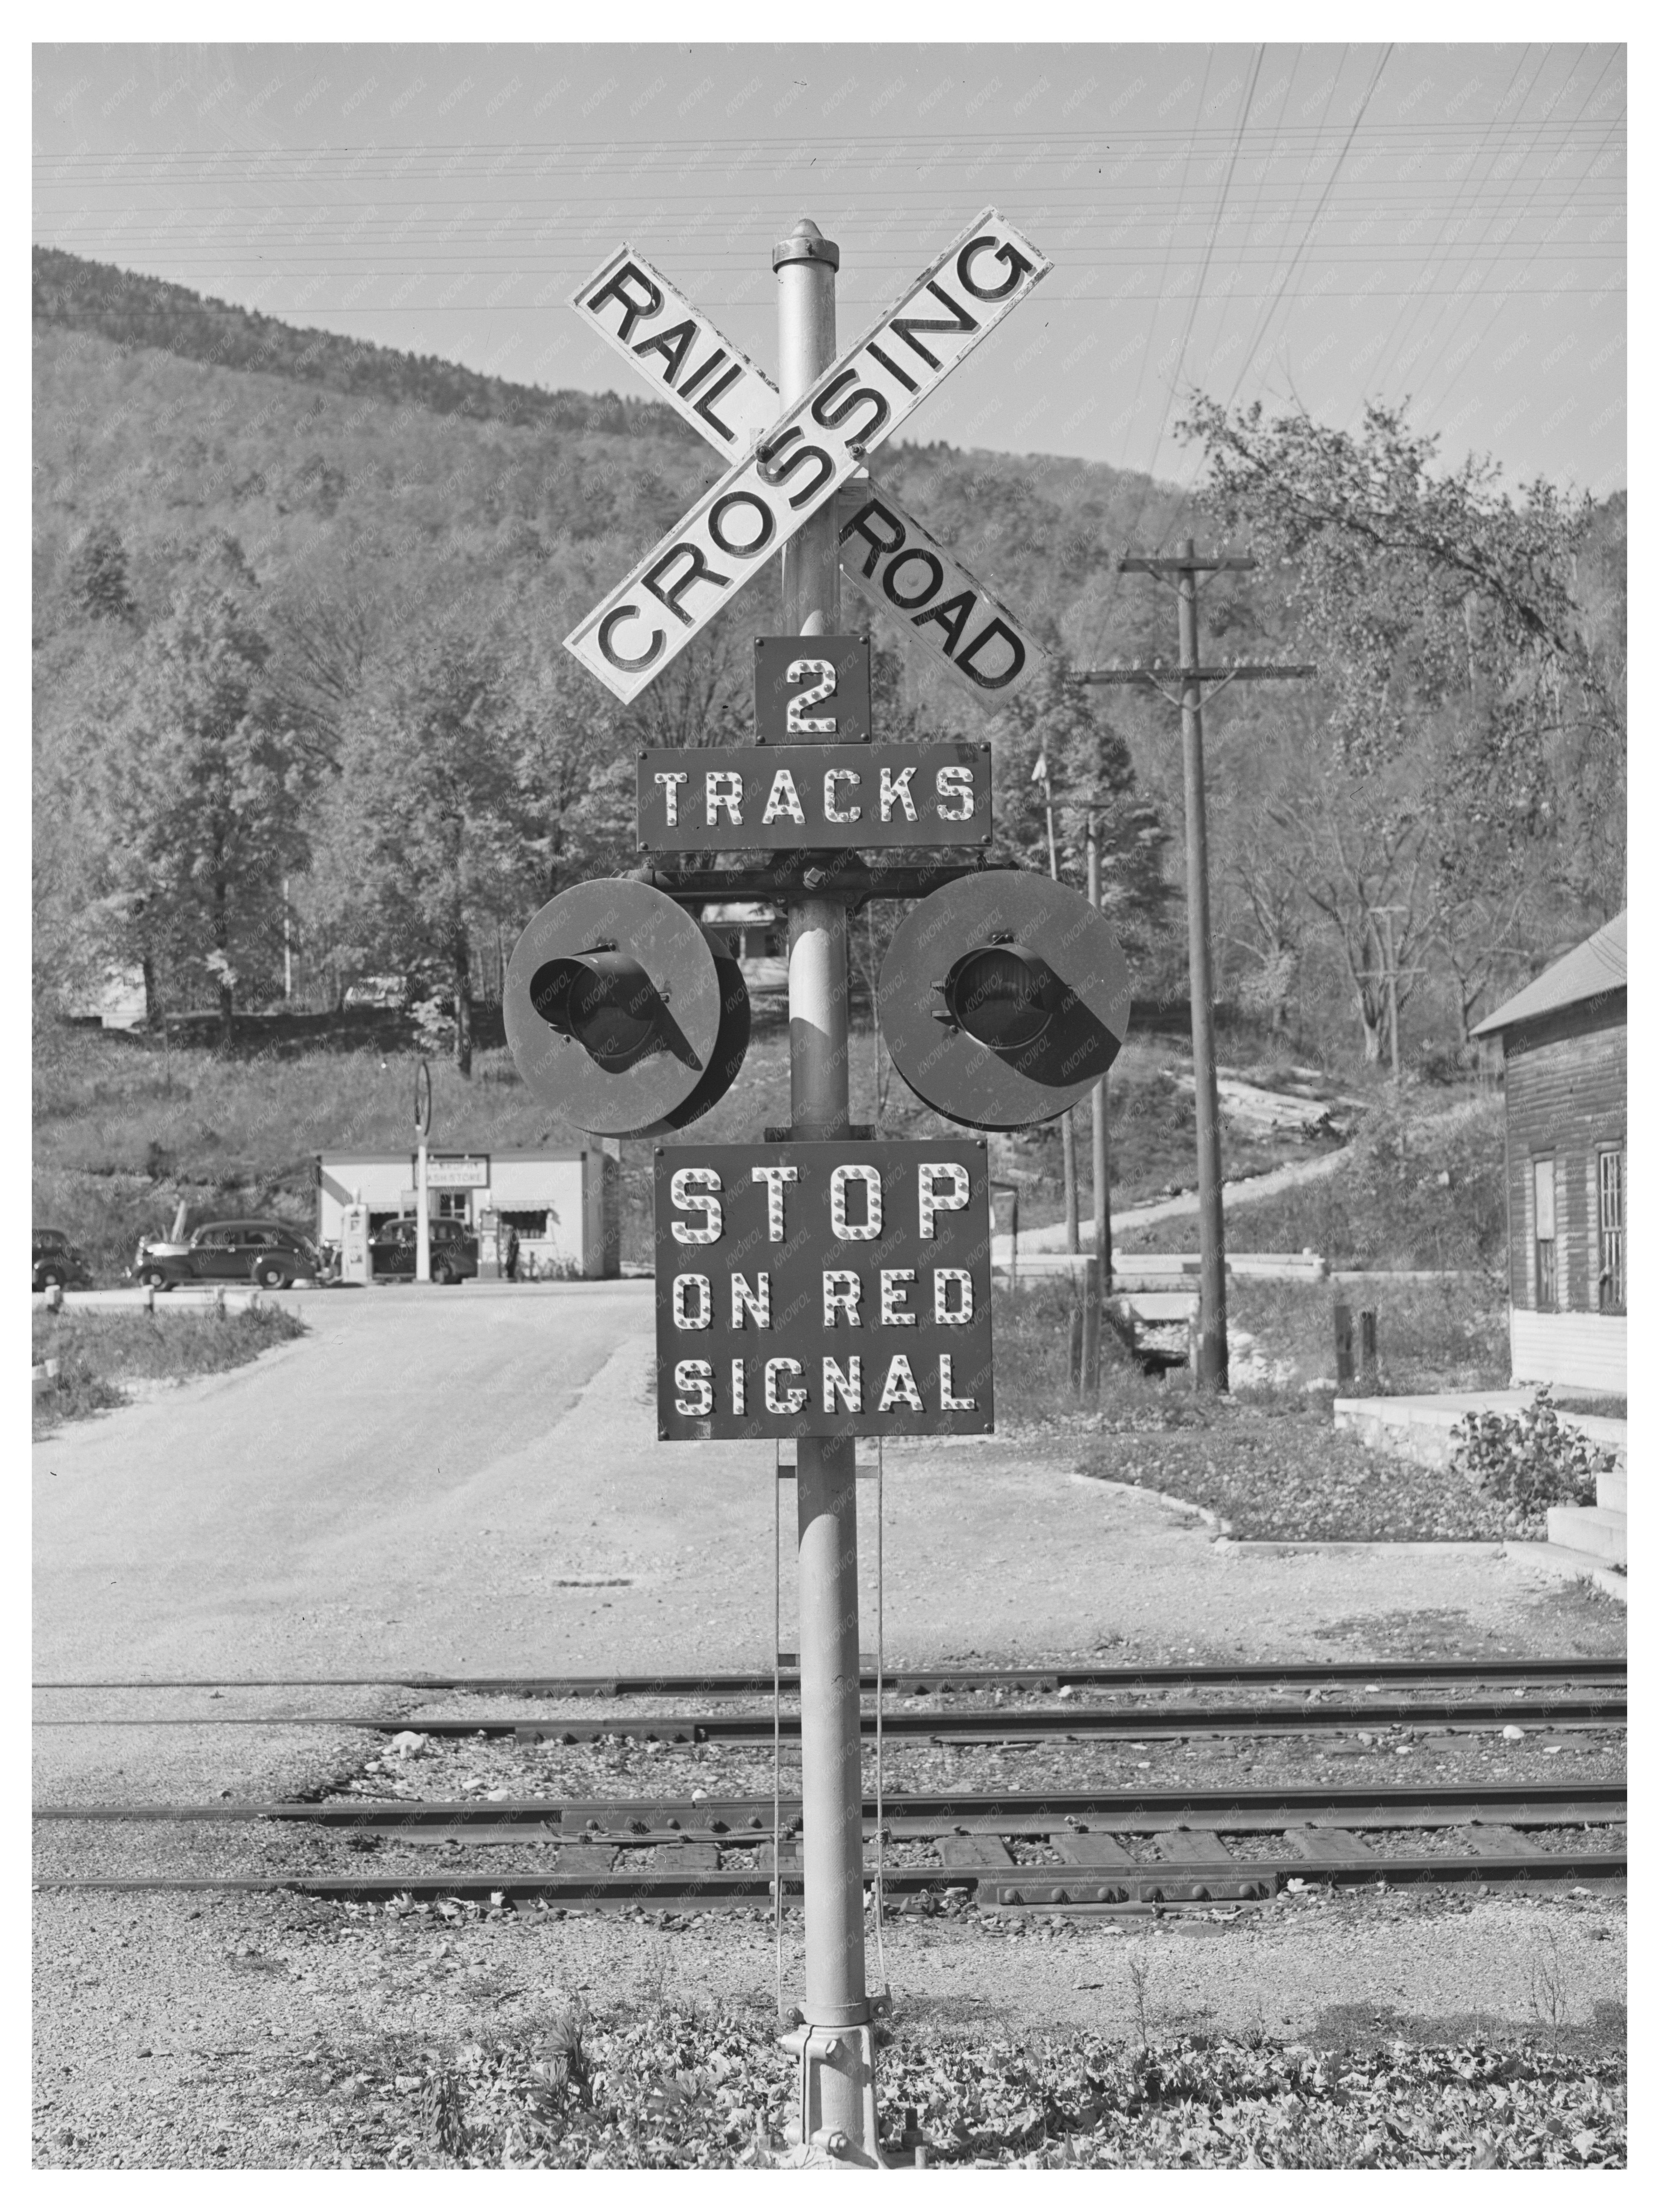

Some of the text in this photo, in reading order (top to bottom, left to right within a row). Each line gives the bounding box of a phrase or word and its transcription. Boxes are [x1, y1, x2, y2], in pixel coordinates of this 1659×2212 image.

[587, 261, 1026, 688] RAIL ROAD
[598, 236, 1036, 671] CROSSING
[787, 660, 836, 732] 2
[654, 767, 974, 826] TRACKS
[449, 1173, 482, 1182] STORE
[671, 1163, 970, 1244] STOP
[673, 1268, 973, 1330] ON RED
[675, 1354, 975, 1416] SIGNAL
